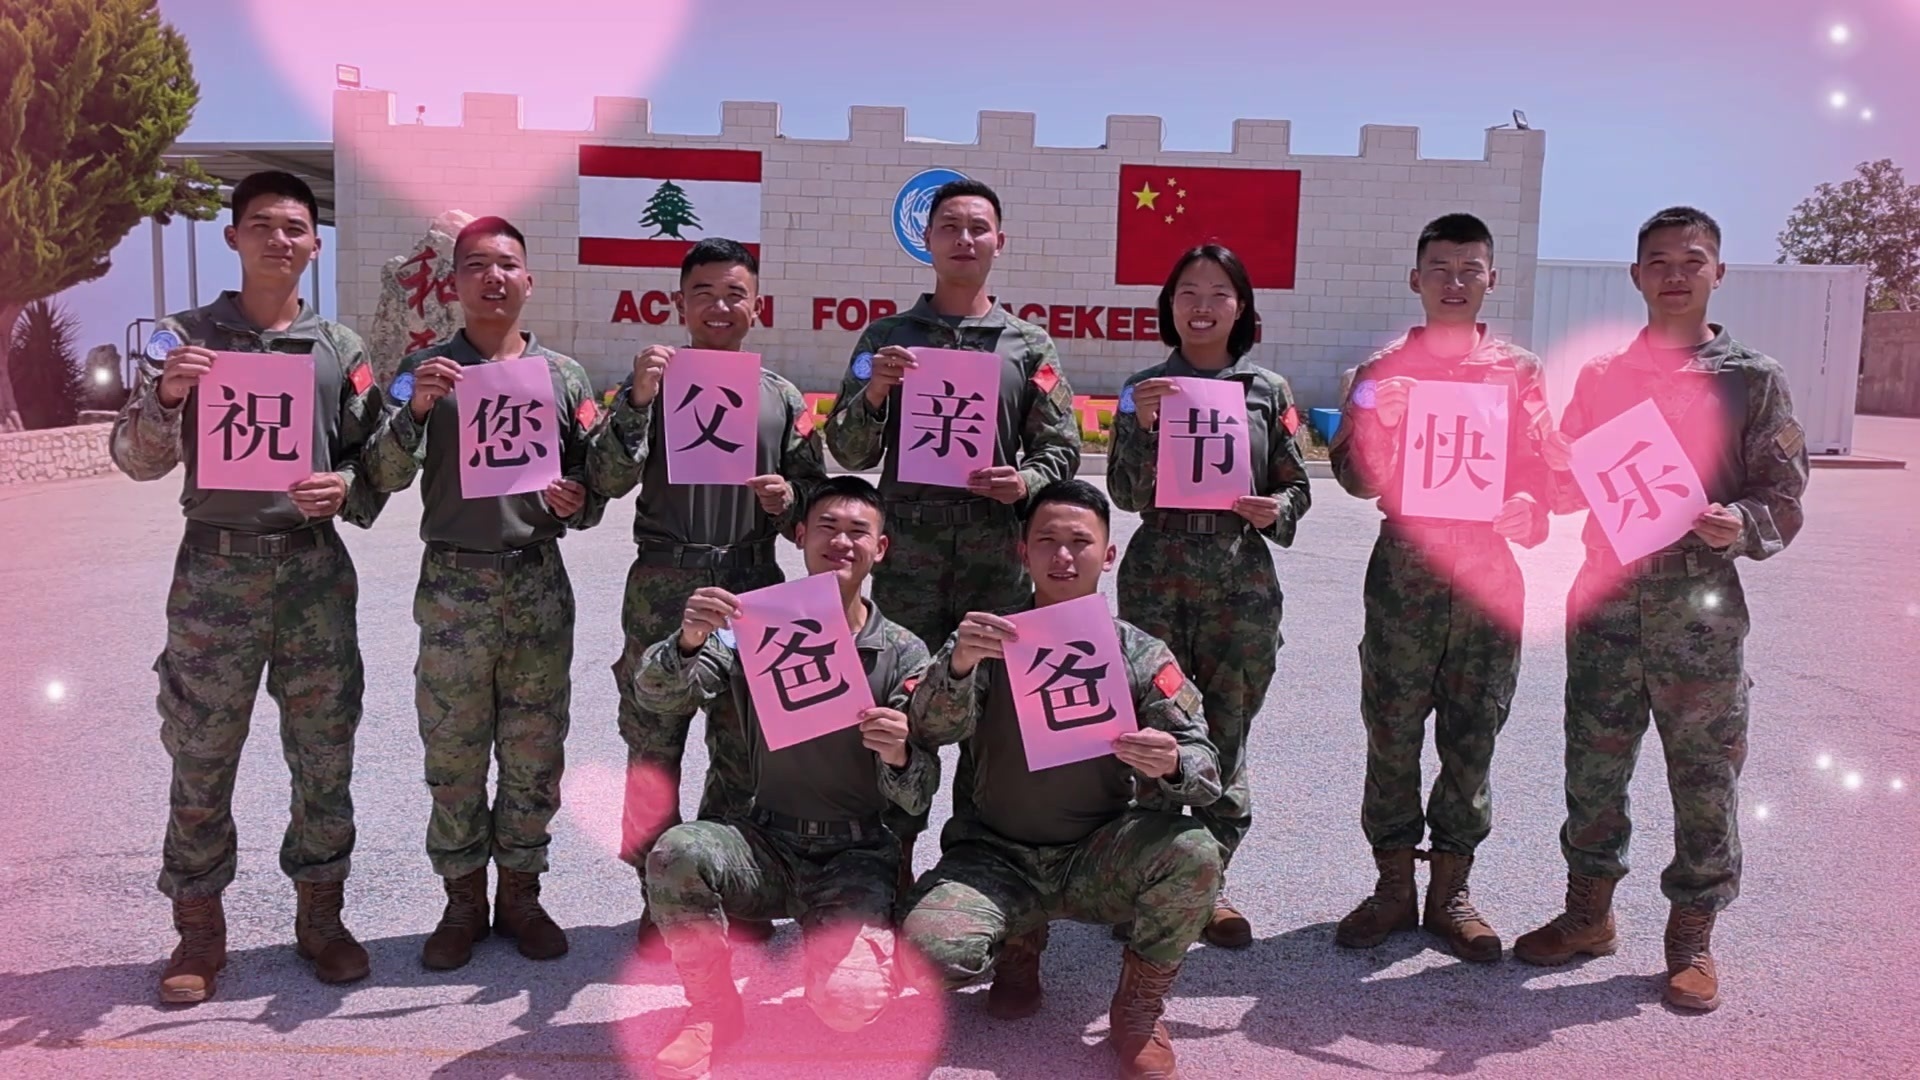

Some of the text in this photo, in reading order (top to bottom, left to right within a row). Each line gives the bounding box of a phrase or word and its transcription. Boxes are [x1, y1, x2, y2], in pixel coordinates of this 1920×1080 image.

[208, 385, 299, 461] 祝
[468, 394, 548, 468] 您
[673, 383, 745, 454] 父
[908, 380, 986, 458] 亲
[1168, 407, 1239, 483] 节
[1413, 412, 1496, 491] 快
[1596, 440, 1690, 534] 乐
[755, 618, 850, 712] 爸
[1024, 640, 1117, 731] 爸
